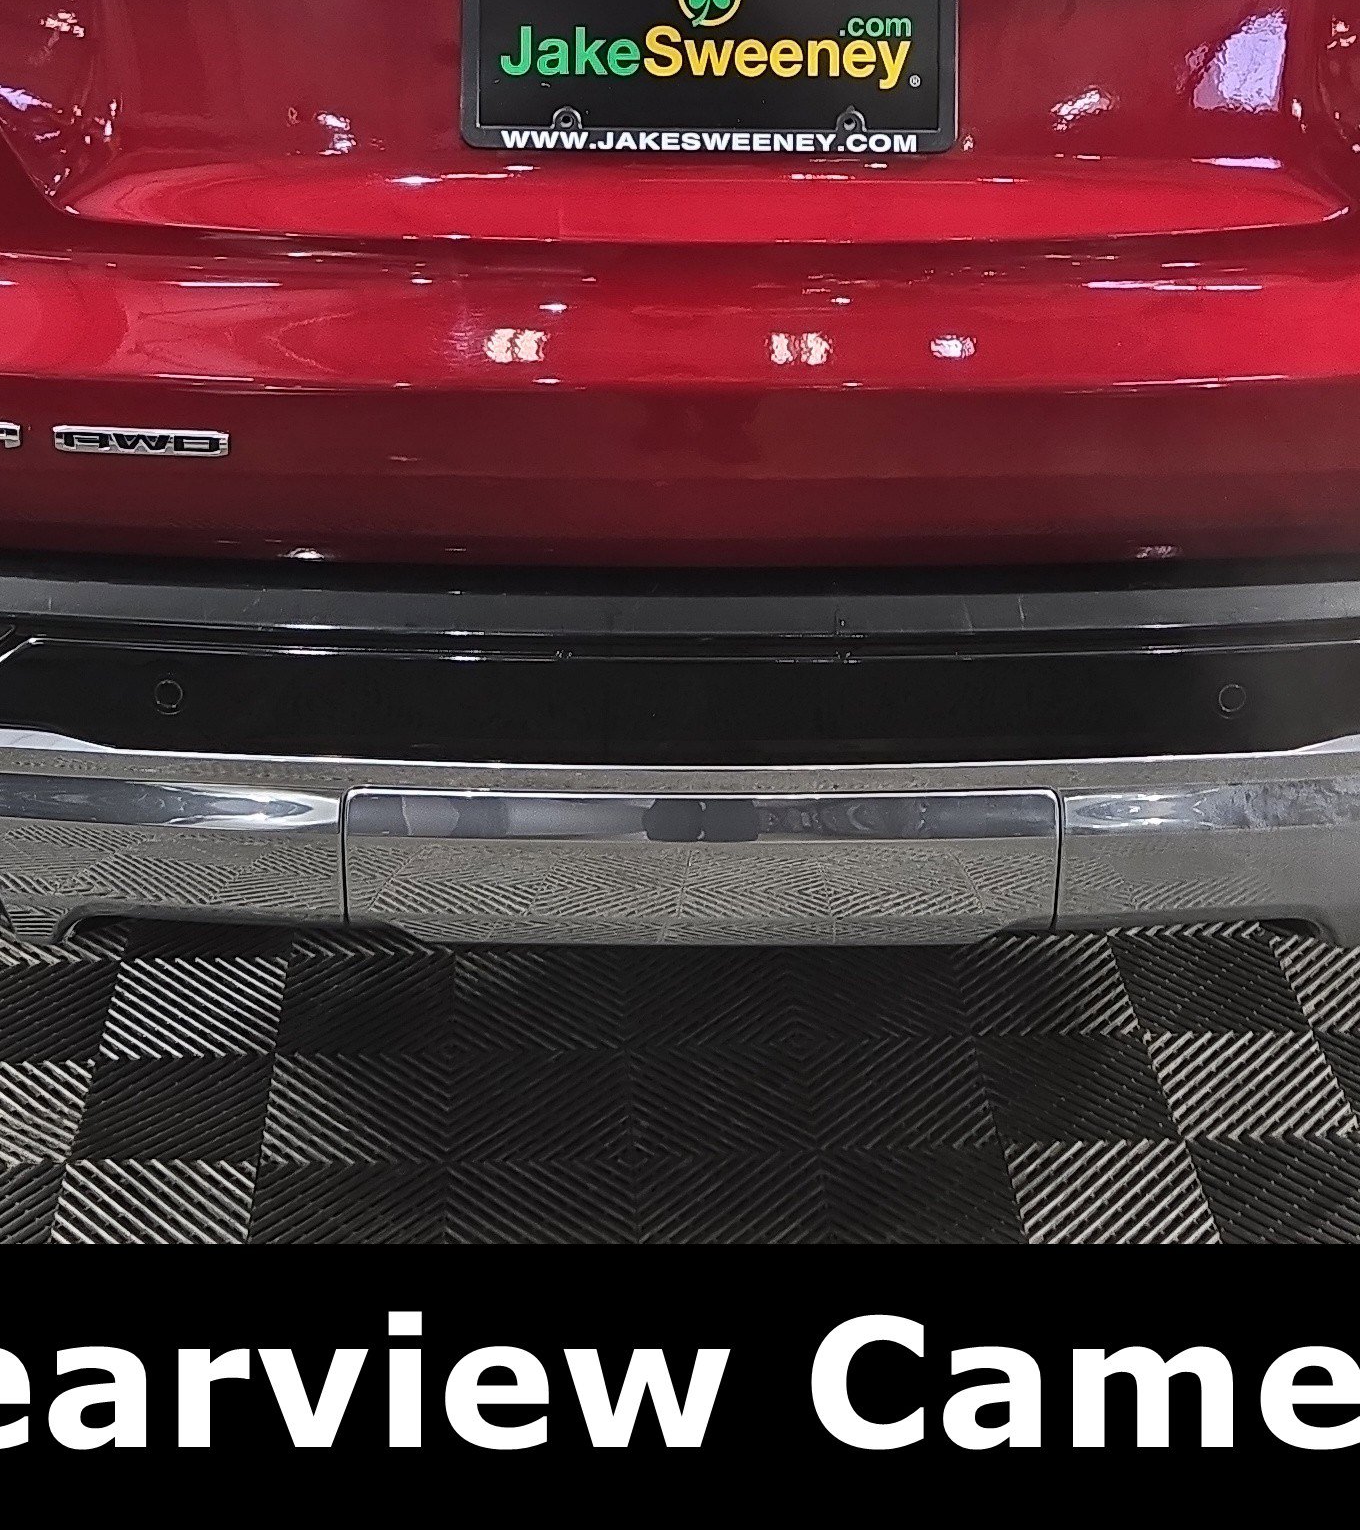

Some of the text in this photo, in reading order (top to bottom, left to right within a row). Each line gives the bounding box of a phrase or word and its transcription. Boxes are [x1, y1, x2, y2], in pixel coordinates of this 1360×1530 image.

[839, 16, 912, 38] .com
[501, 129, 918, 153] WWW.JAKESWEENEY.COM
[64, 427, 222, 455] AWD
